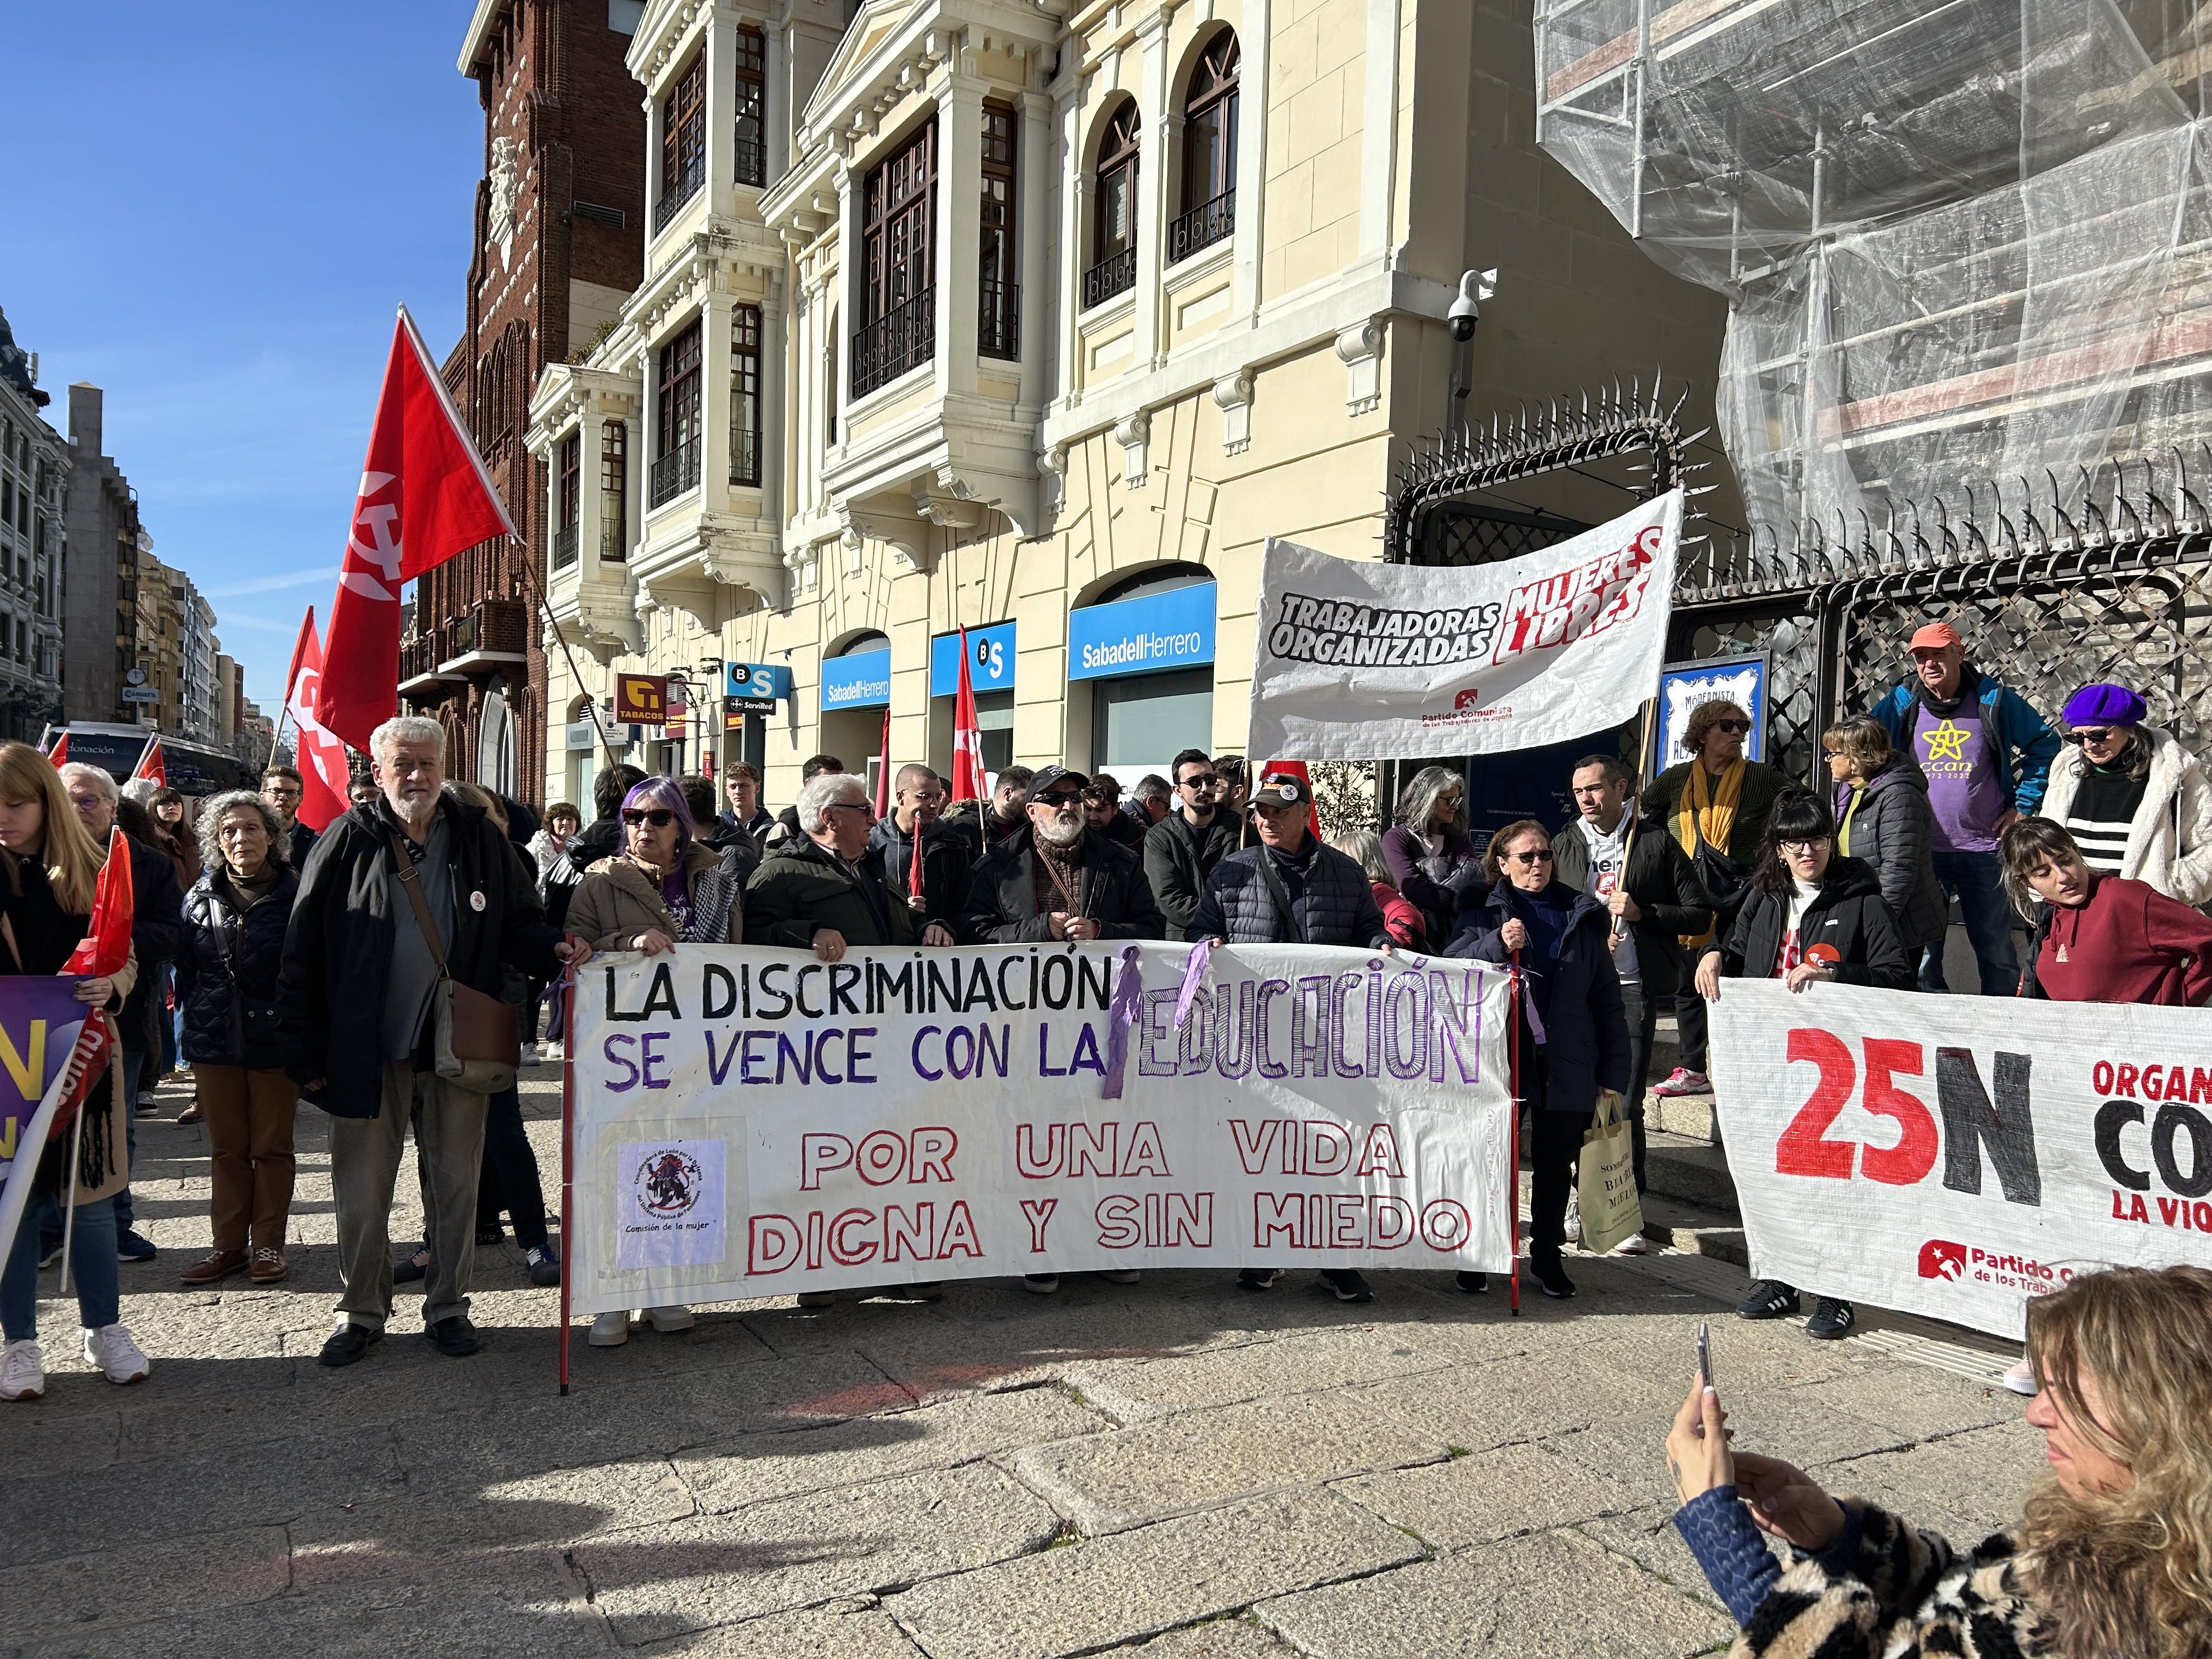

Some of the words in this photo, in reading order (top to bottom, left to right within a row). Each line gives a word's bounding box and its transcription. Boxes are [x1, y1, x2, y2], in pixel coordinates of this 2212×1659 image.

[1504, 526, 1663, 623] MUJERES
[1282, 592, 1502, 638] TRABAJADORAS
[990, 642, 1003, 679] S
[1268, 622, 1493, 667] ORGANIZADAS
[737, 669, 746, 680] B
[752, 670, 772, 696] S
[620, 711, 663, 720] TABACOS
[744, 701, 772, 710] ServiRed
[1422, 713, 1458, 722] Partido
[1460, 707, 1512, 718] Comunista
[67, 742, 114, 754] donación
[605, 962, 682, 1022] LA
[603, 1031, 672, 1092] SE
[705, 1028, 878, 1085] VENCE
[912, 1023, 1010, 1081] CON
[1040, 1022, 1107, 1077] LA
[1139, 956, 1482, 1084] EDUCACIÓN
[1776, 1028, 2041, 1206] 25N
[799, 1126, 957, 1192] POR
[1017, 1121, 1172, 1178] UNA
[1229, 1119, 1407, 1179] VIDA
[2094, 1100, 2212, 1198] CO
[2112, 1189, 2150, 1224] LA
[625, 1223, 659, 1233] Comisión
[662, 1221, 672, 1231] de
[676, 1221, 683, 1230] la
[686, 1221, 709, 1231] mujer
[744, 1200, 986, 1276] DIGNA
[1020, 1199, 1058, 1253] Y
[1097, 1191, 1214, 1249] SIN
[1253, 1192, 1471, 1252] MIEDO
[1971, 1248, 2053, 1280] Partido
[1975, 1269, 1990, 1282] de
[1996, 1272, 2016, 1287] los
